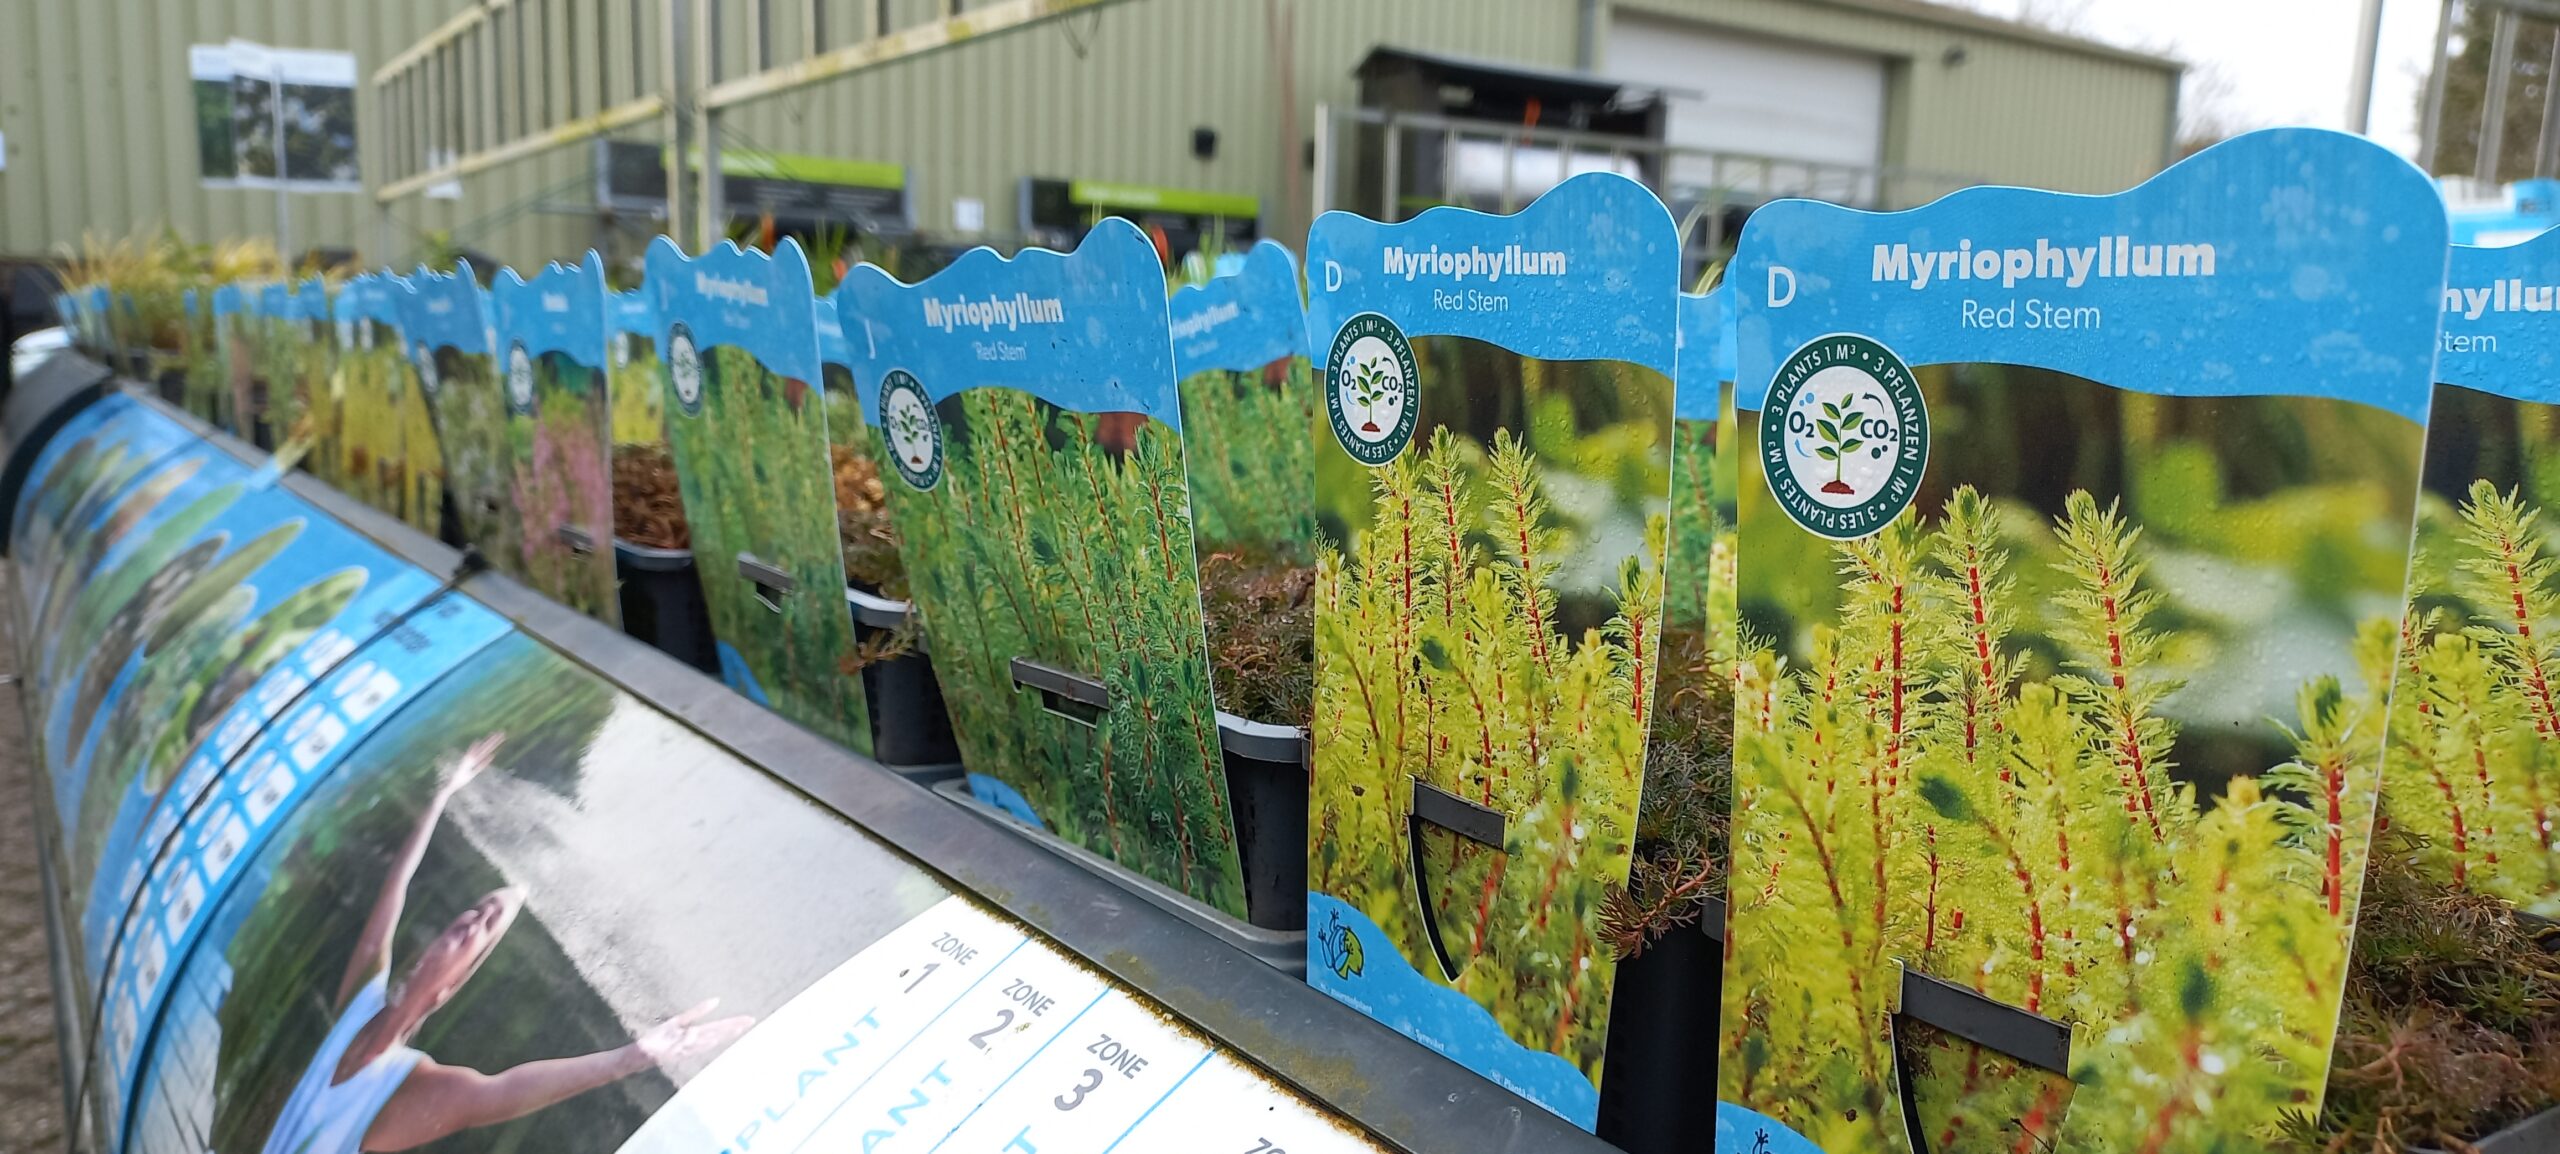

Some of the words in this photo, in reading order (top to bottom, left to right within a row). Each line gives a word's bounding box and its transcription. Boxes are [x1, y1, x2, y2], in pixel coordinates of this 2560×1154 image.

[1325, 261, 1342, 292] D
[1383, 244, 1566, 282] Myriophyllum
[1871, 236, 2215, 290] Myriophyllum
[1434, 288, 1463, 310] Red
[1467, 290, 1508, 312] Stem
[1768, 266, 1796, 308] D
[2442, 278, 2560, 320] hyllu
[923, 293, 1064, 333] Myriophyllum
[1961, 299, 2015, 329] Red
[2024, 299, 2101, 330] Stem
[1825, 346, 1831, 361] 1
[1874, 357, 1885, 373] 3
[1776, 350, 1821, 403] PLANTS
[1771, 405, 1784, 416] 3
[1883, 366, 1920, 462] PFLANZEN
[1774, 467, 1785, 477] 1
[1900, 466, 1914, 475] 1
[1780, 478, 1835, 529] PLANTES
[1839, 511, 1866, 530] LES
[1868, 506, 1879, 521] 3
[931, 931, 978, 966] ZONE
[903, 963, 941, 994] 1
[1002, 978, 1055, 1017] ZONE
[968, 1008, 1015, 1050] 2
[1087, 1033, 1149, 1080] ZONE
[1054, 1068, 1104, 1111] 3
